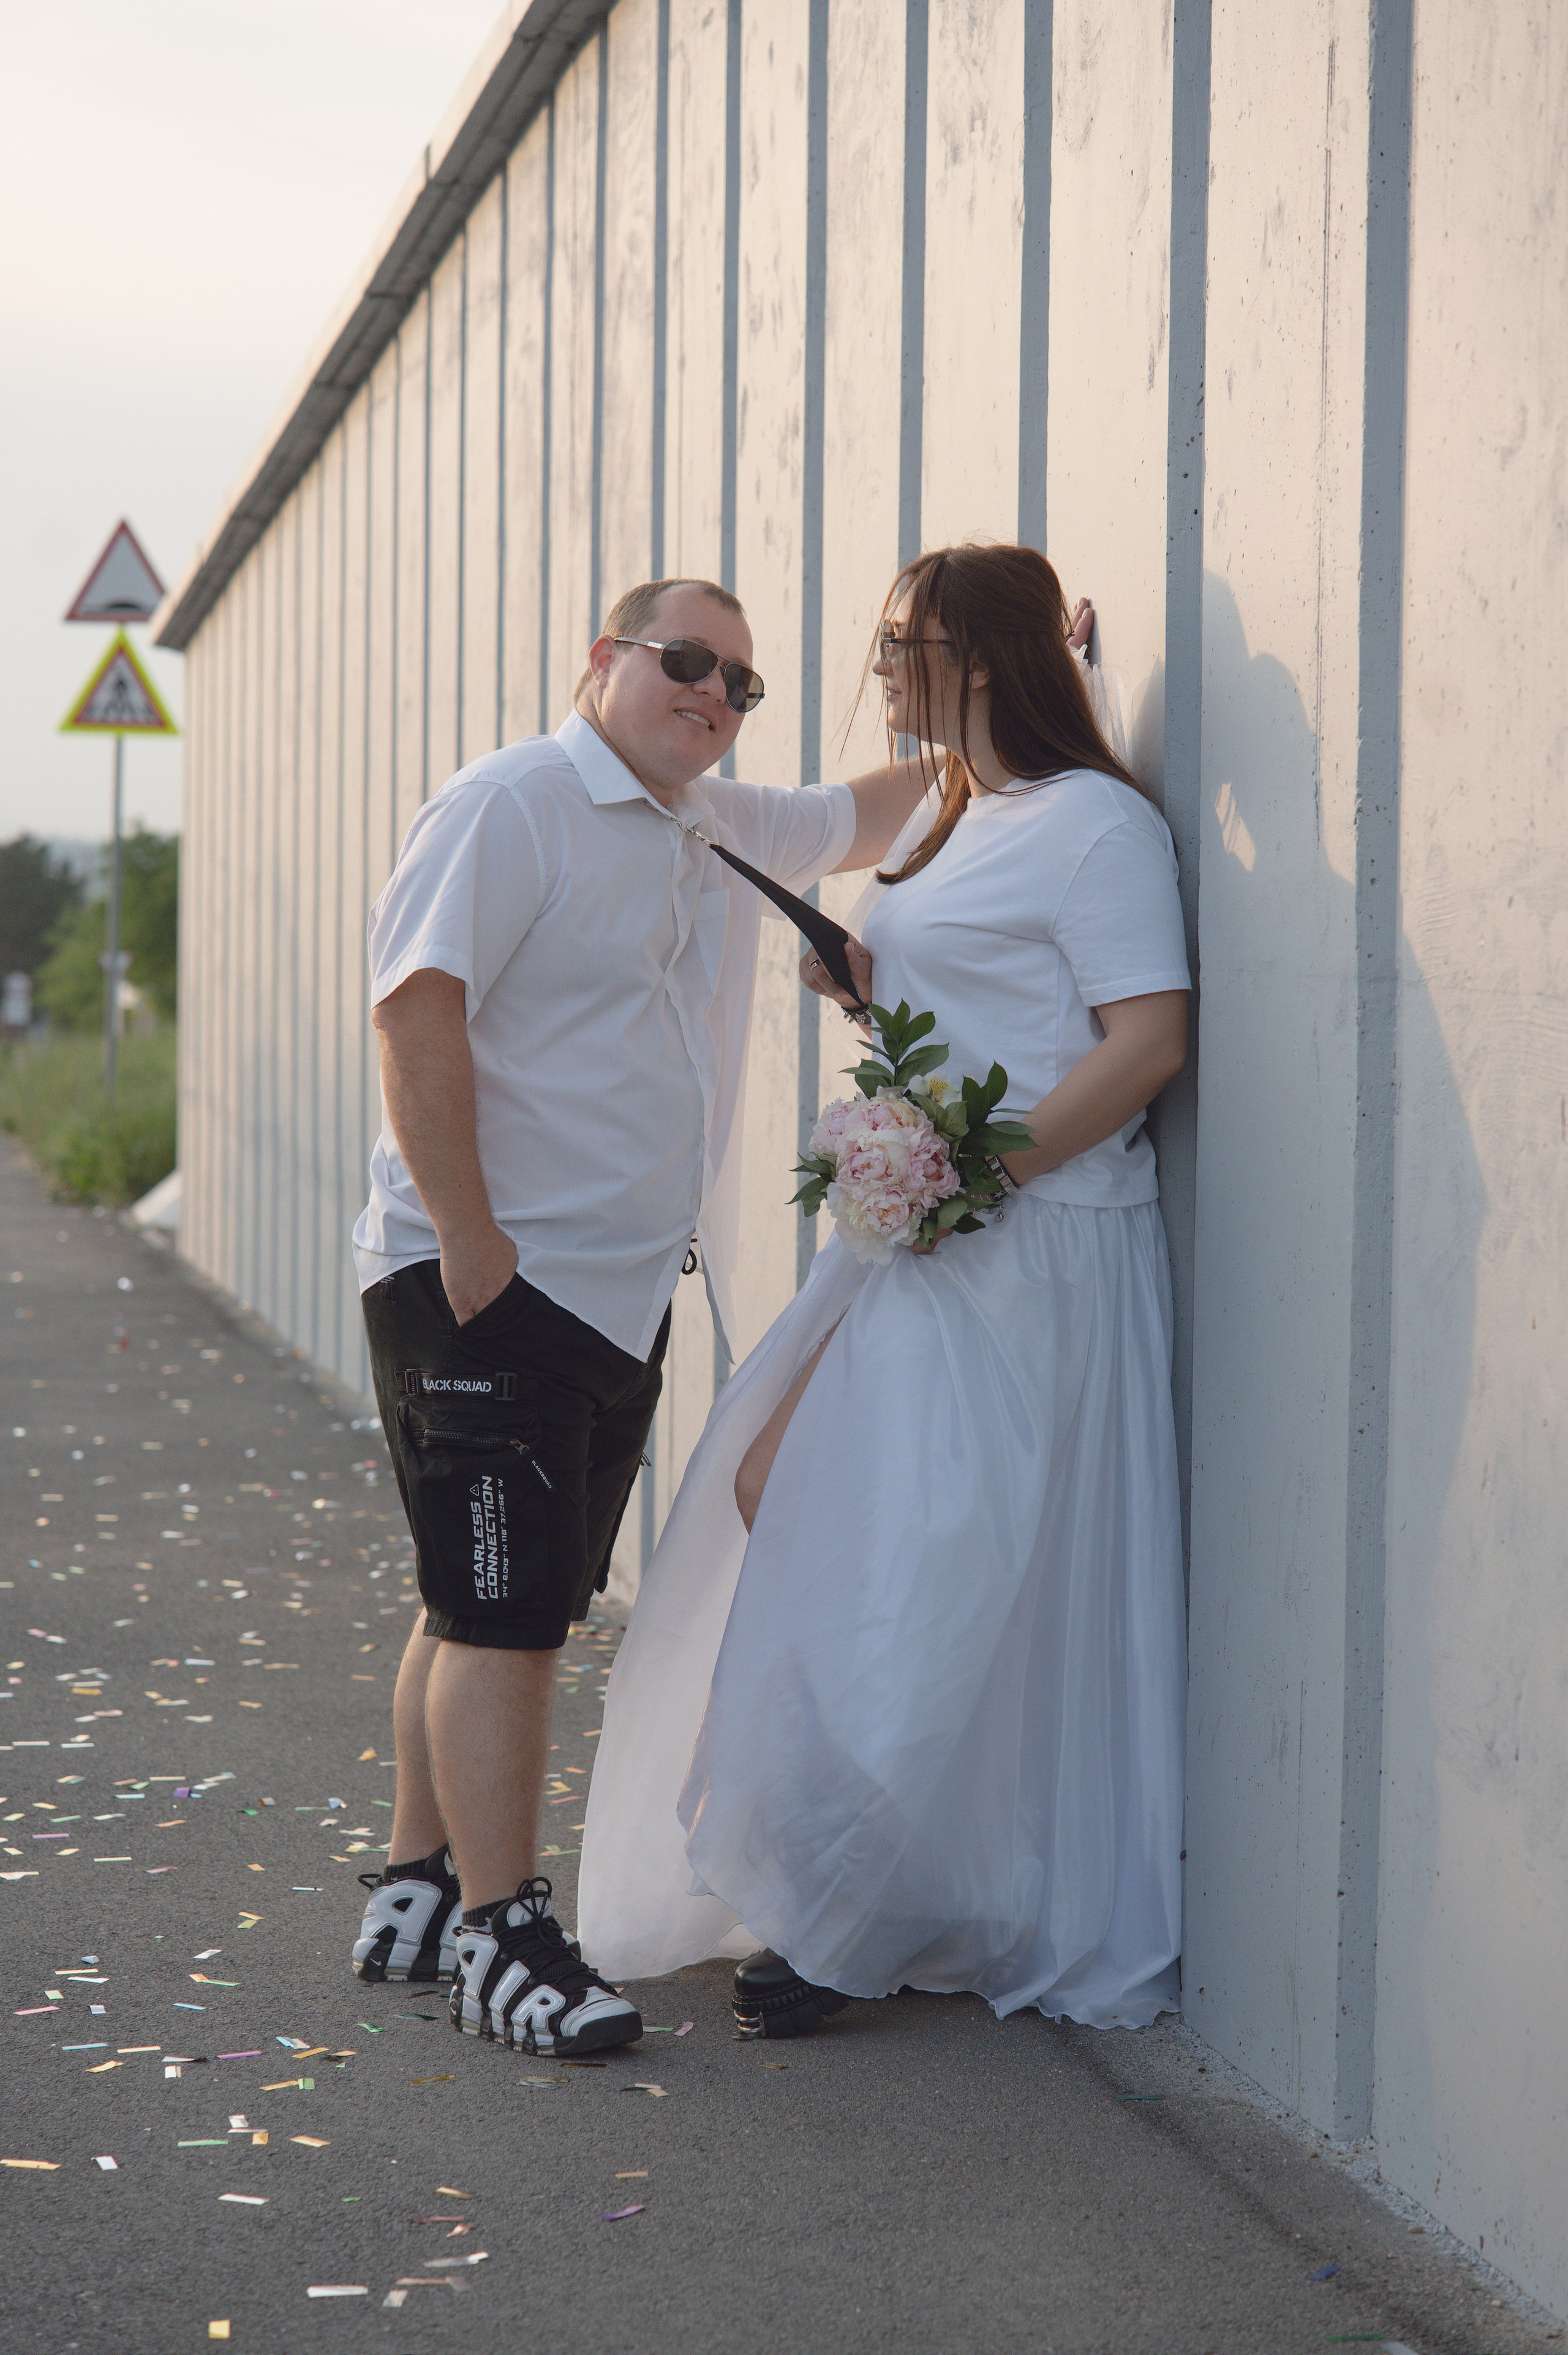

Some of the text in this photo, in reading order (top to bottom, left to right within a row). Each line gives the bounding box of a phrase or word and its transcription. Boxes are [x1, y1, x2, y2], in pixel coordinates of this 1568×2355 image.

[453, 1379, 492, 1393] SQUAD
[497, 1478, 504, 1487] W
[531, 1460, 552, 1489] BLACKSQUAD
[470, 1501, 488, 1600] FEARLESS
[481, 1475, 499, 1600] CONNECTION
[456, 1932, 567, 2033] AIR
